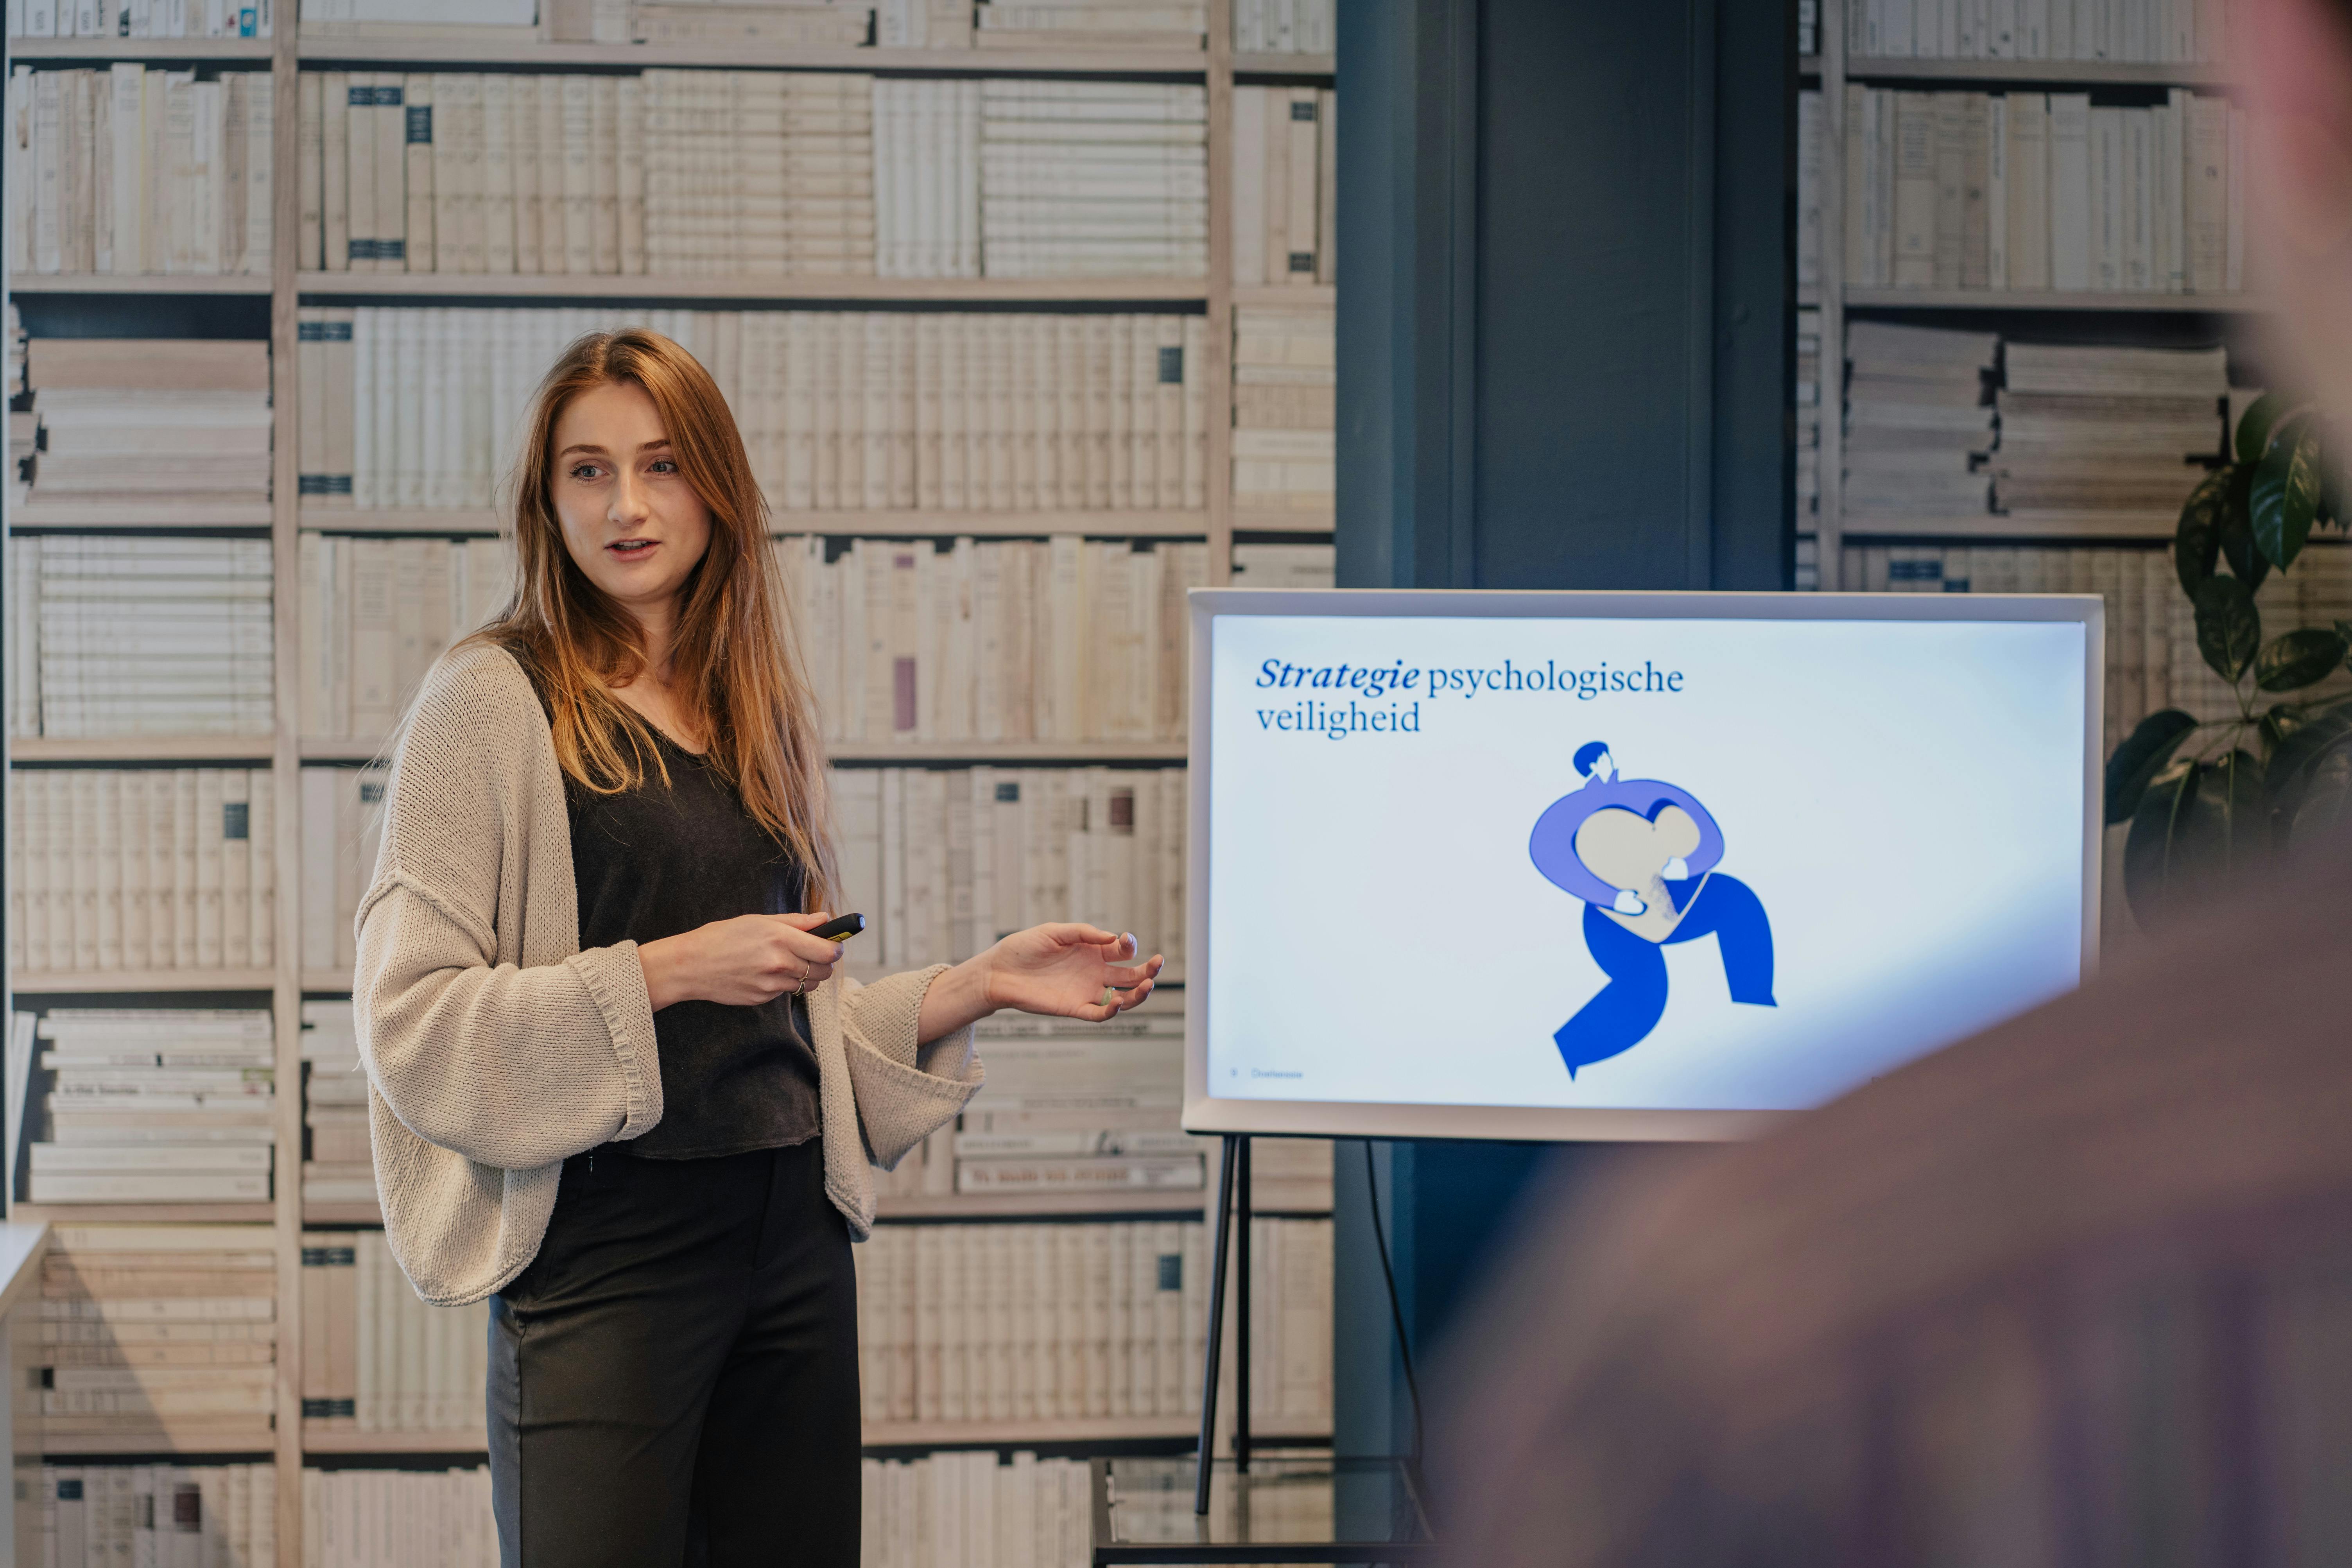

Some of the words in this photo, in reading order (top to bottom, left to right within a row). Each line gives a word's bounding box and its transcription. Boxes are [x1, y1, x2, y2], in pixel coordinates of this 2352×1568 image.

[1255, 658, 1421, 699] Strategie
[1427, 659, 1684, 701] psychologische
[1256, 700, 1421, 741] veiligheid
